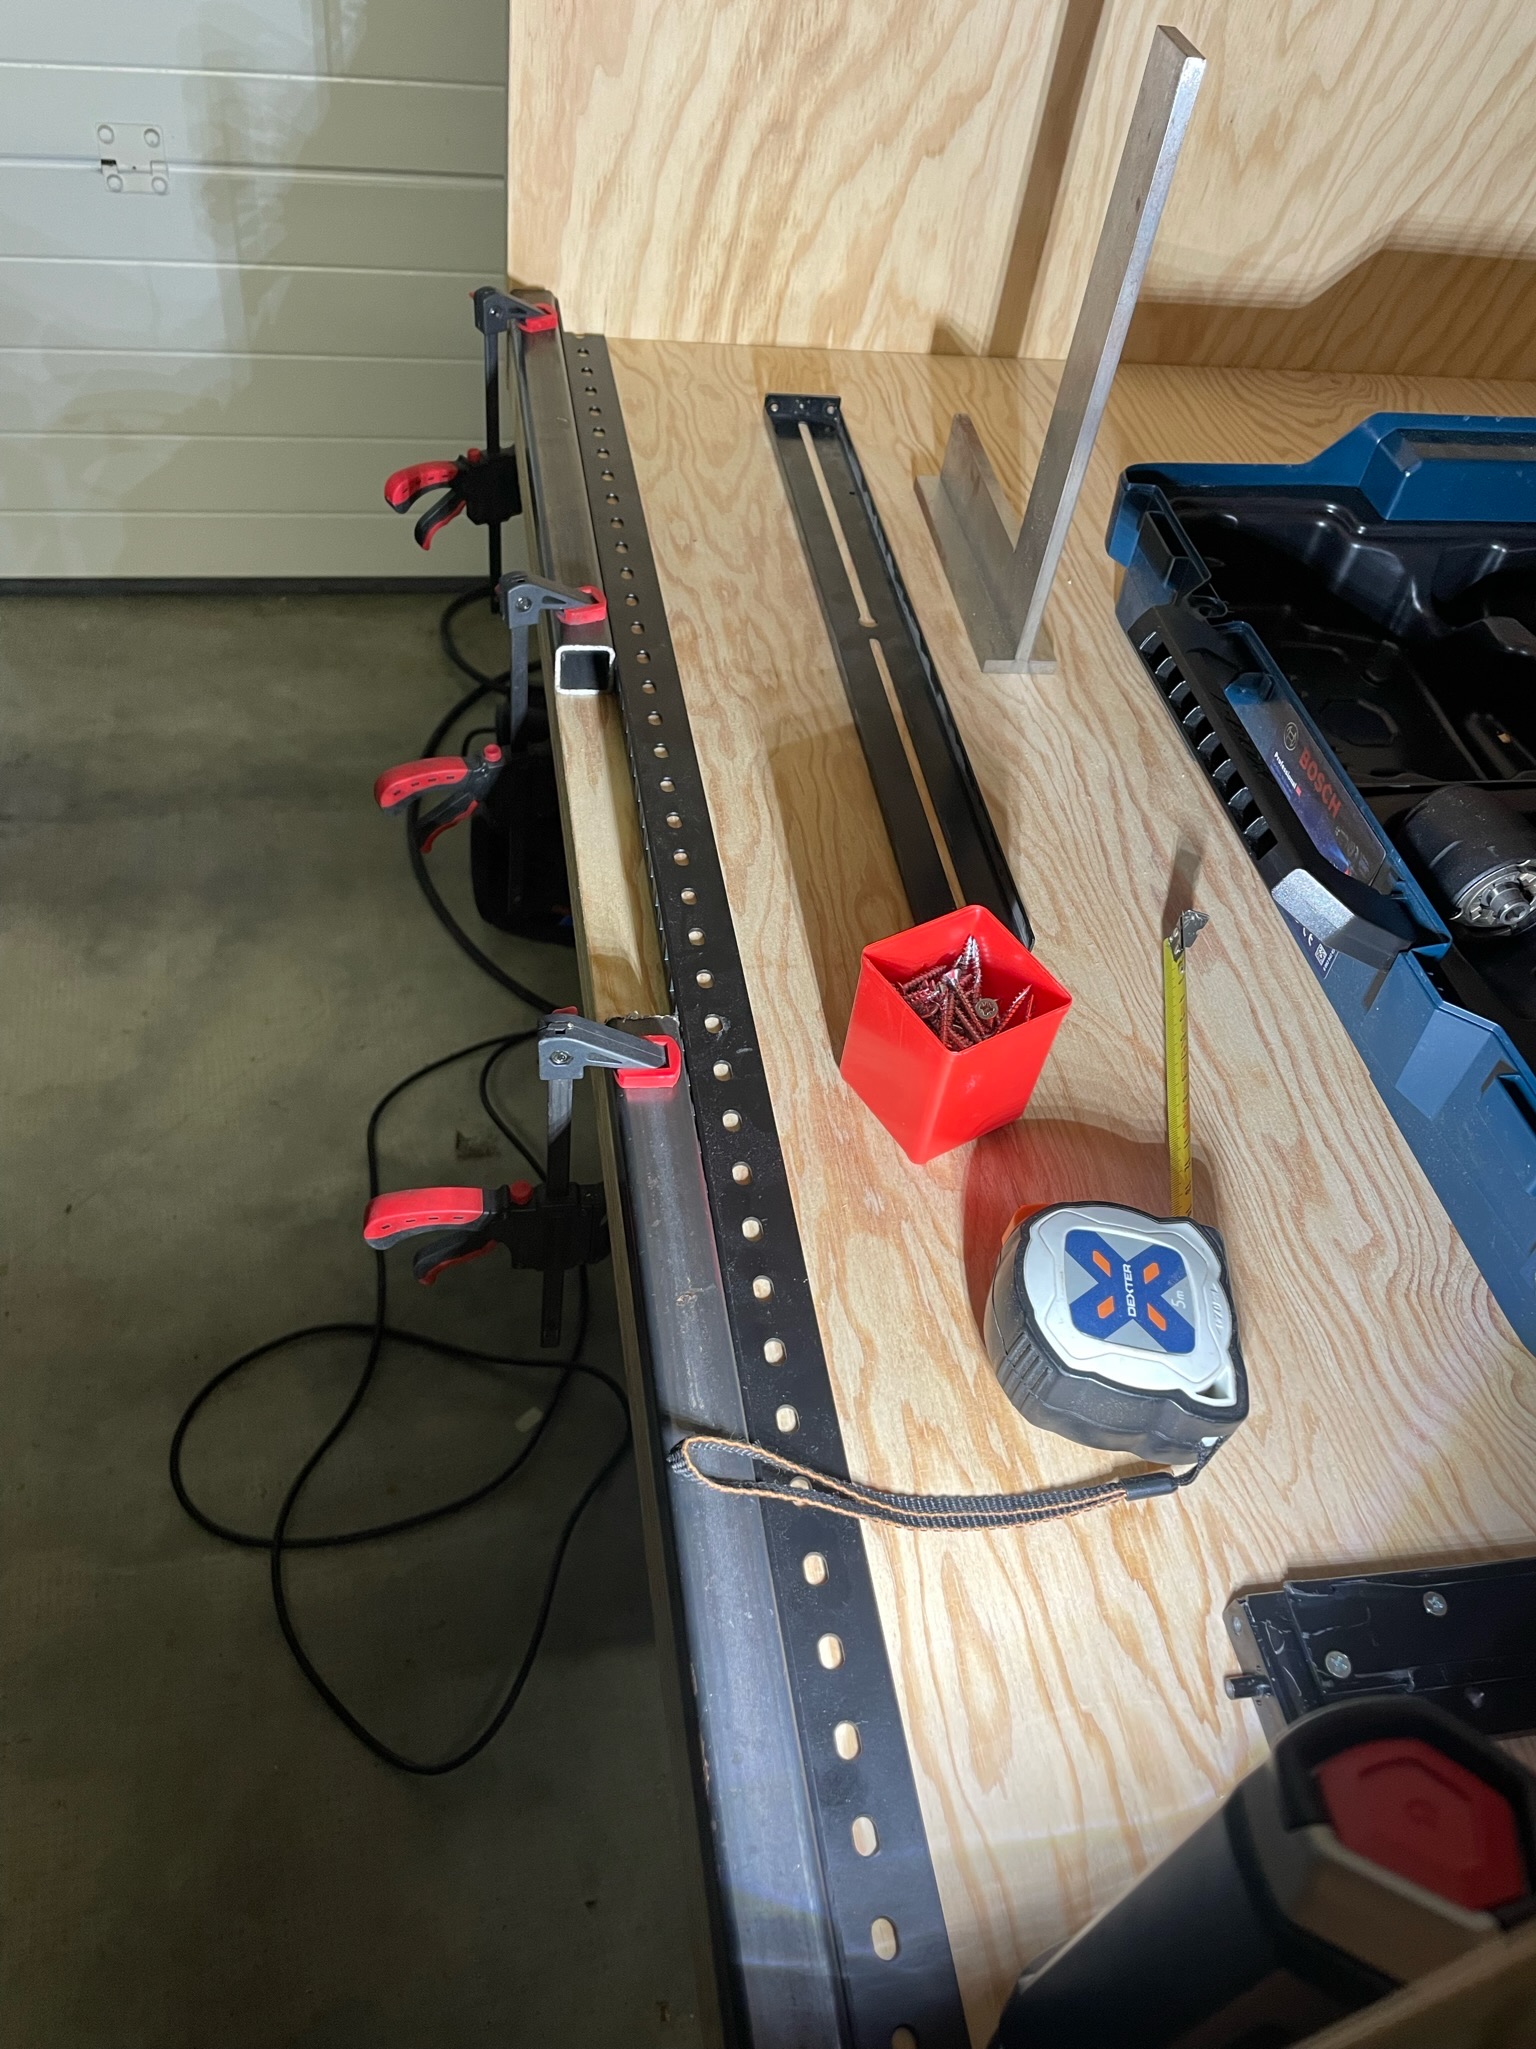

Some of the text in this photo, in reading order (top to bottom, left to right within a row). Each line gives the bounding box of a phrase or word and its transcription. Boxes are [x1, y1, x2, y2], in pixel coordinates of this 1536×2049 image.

[1273, 751, 1298, 790] Professional
[1299, 750, 1342, 818] BOSCH
[1122, 1263, 1137, 1318] DEXTER
